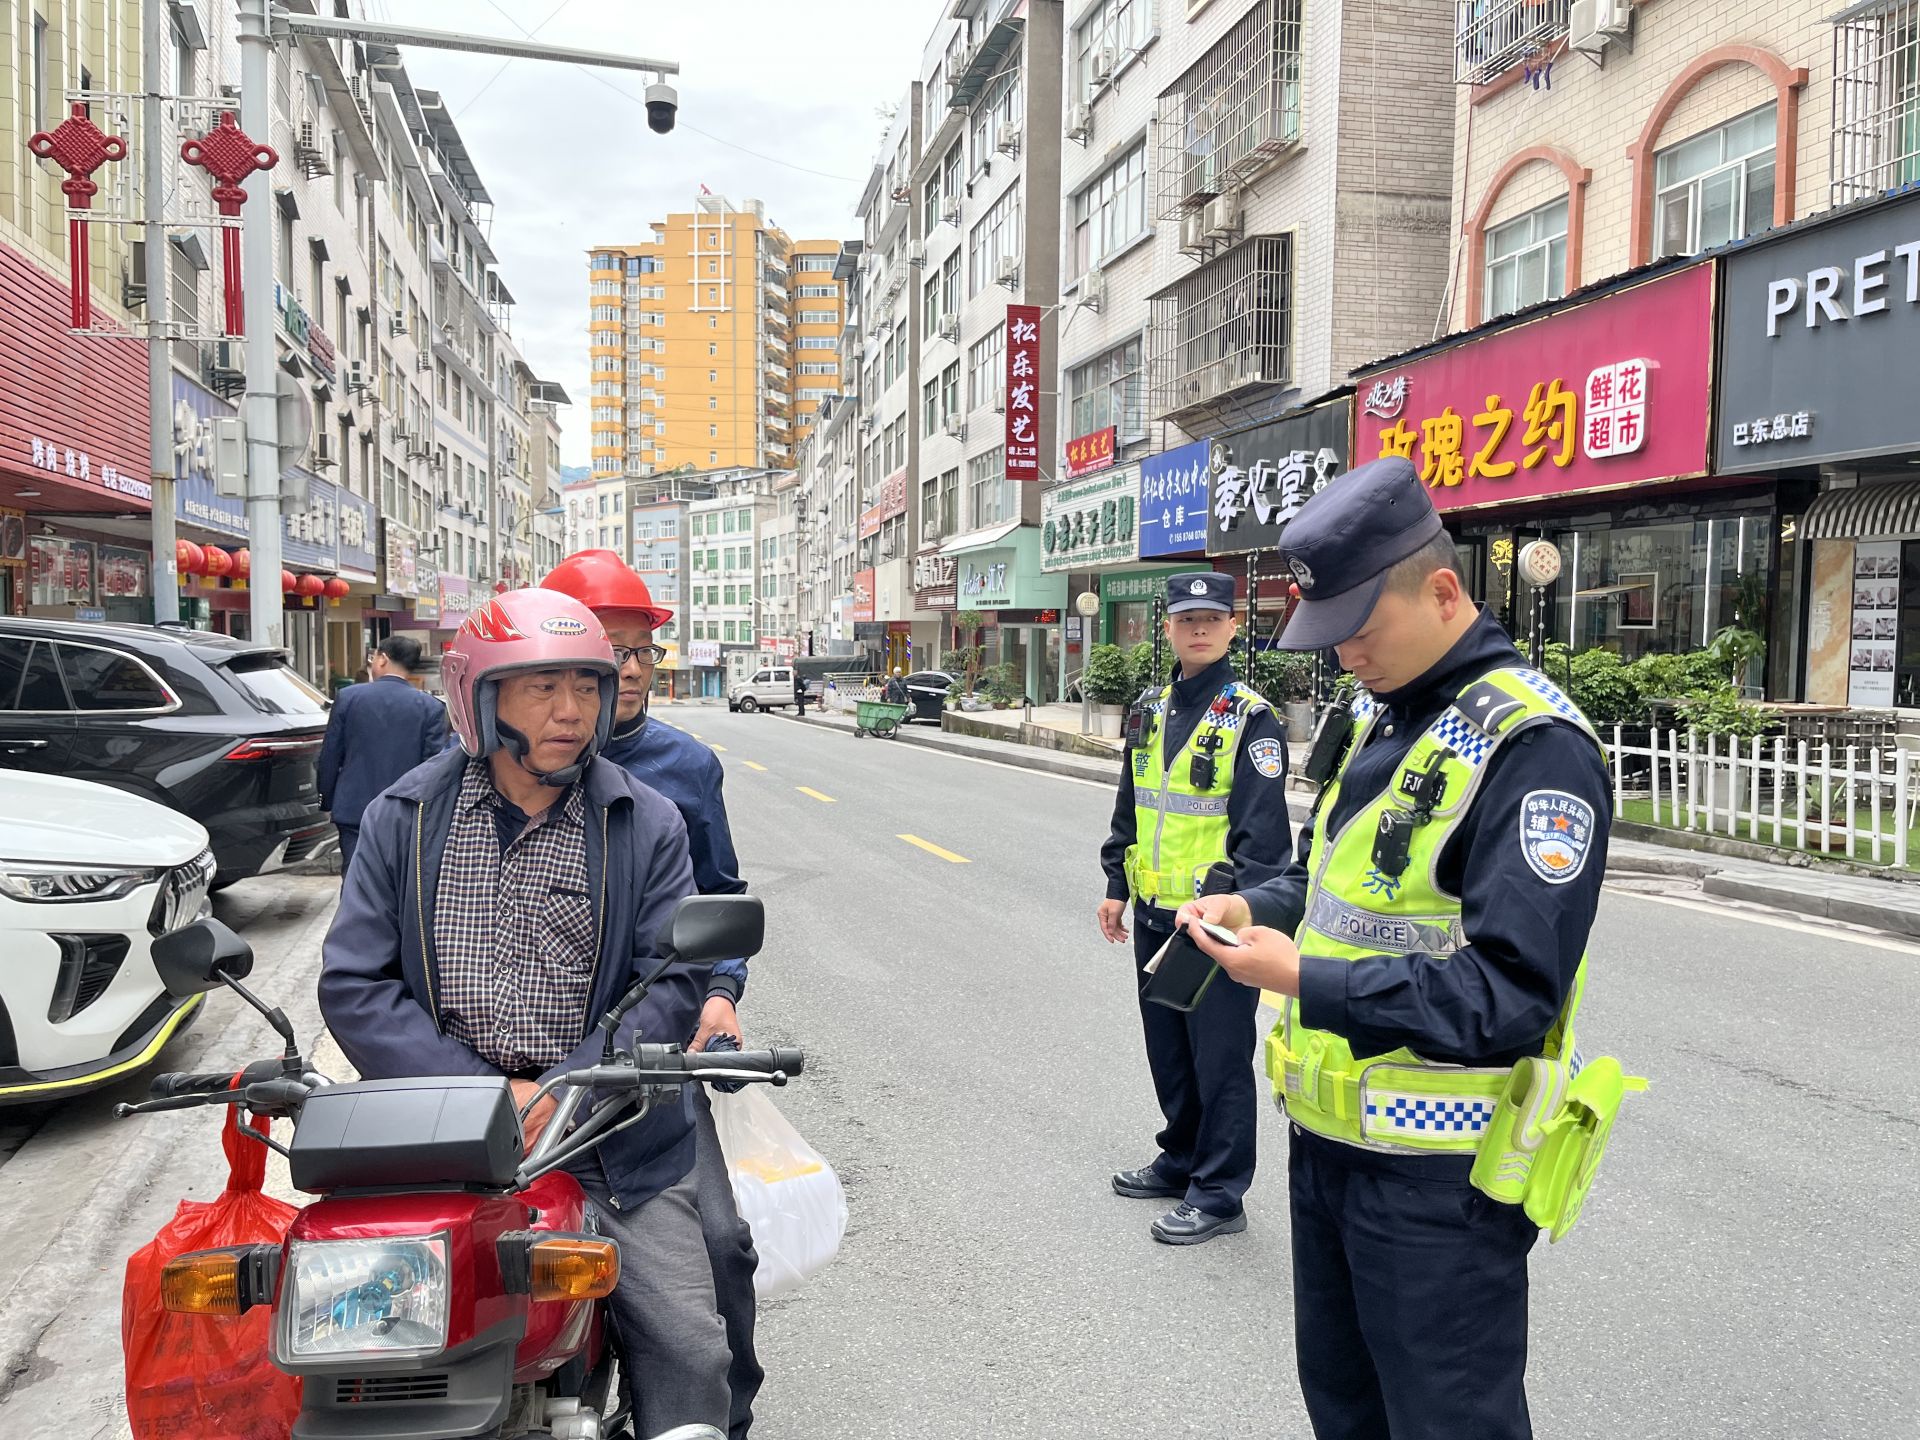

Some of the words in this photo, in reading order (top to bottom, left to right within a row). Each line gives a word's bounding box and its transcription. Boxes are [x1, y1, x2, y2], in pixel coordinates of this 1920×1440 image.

[1766, 241, 1920, 337] PRET
[1011, 318, 1037, 443] 松乐发艺
[1589, 365, 1642, 408] 鲜花
[1378, 378, 1578, 489] 玫瑰之约
[1588, 411, 1641, 451] 超市
[1733, 412, 1809, 446] 巴东总店
[1162, 505, 1185, 528] 仓库
[1134, 752, 1151, 778] 警
[1187, 800, 1220, 811] POLICE
[1528, 798, 1591, 828] 中华人民共和国
[1530, 814, 1549, 831] 辅
[1340, 914, 1406, 943] POLICE
